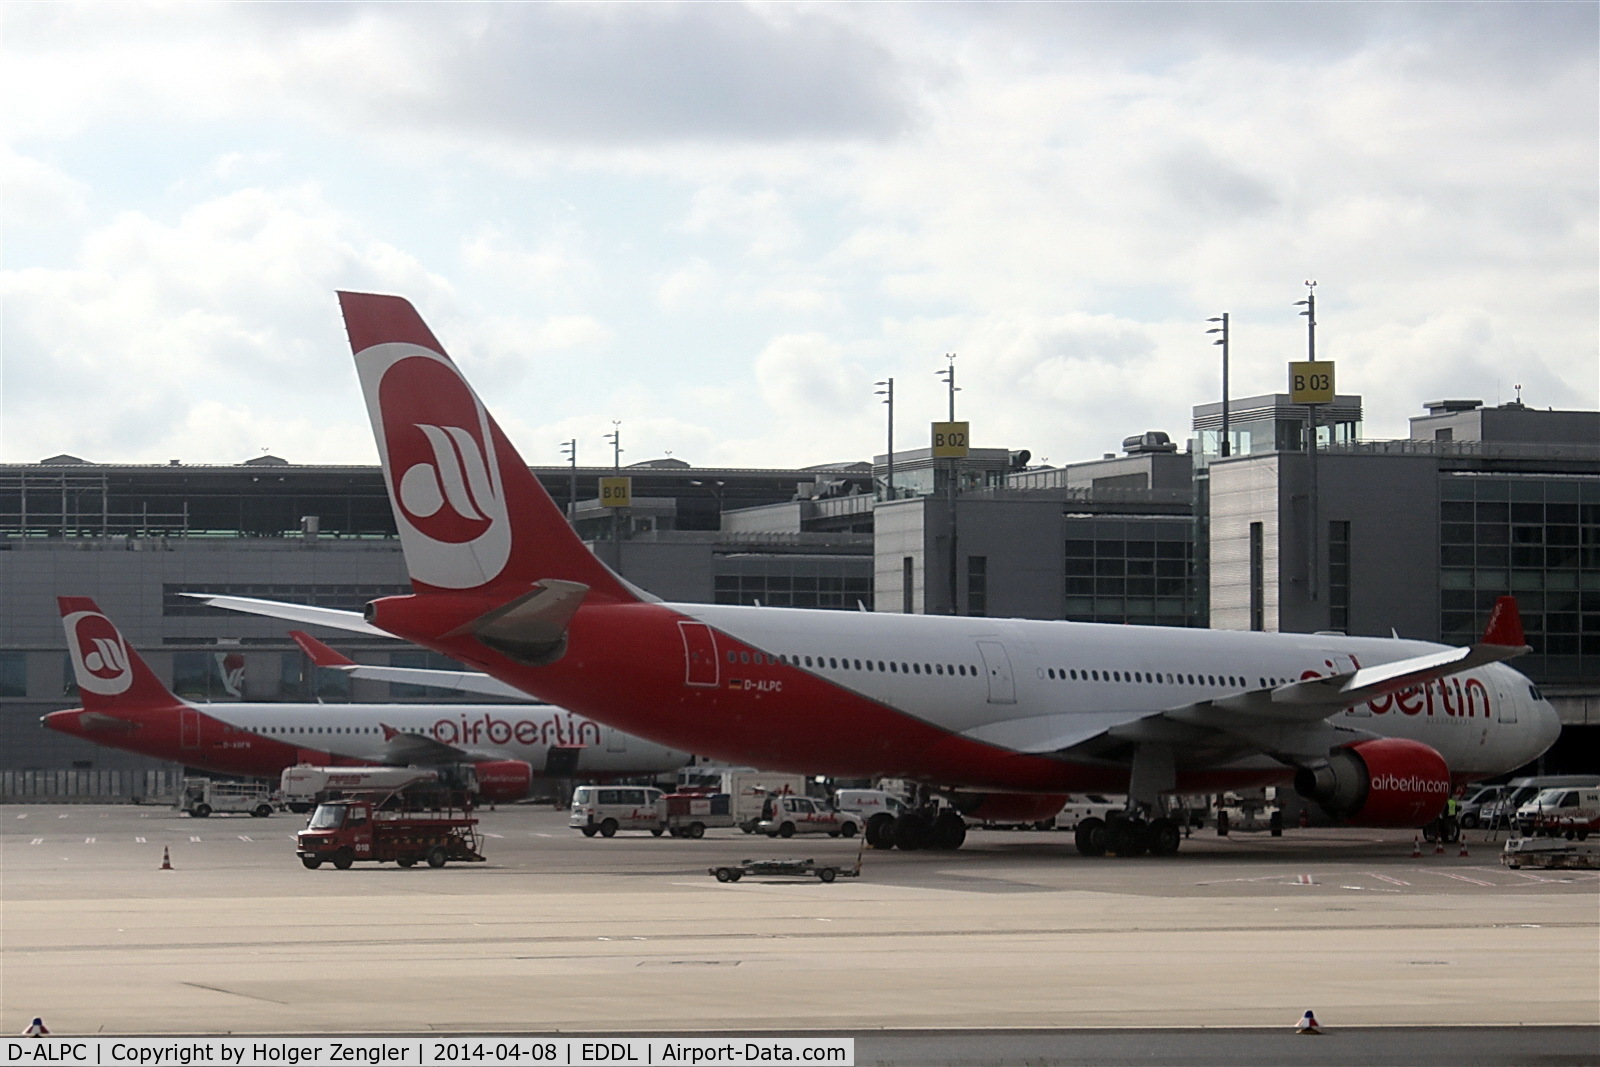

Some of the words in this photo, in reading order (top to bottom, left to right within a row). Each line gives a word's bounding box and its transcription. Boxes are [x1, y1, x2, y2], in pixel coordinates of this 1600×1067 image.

[1294, 375, 1305, 391] B
[1310, 374, 1329, 391] 03
[935, 433, 945, 447] B
[948, 432, 965, 447] 02
[603, 486, 611, 499] B
[614, 486, 626, 499] 01
[744, 679, 782, 692] D-ALPC
[434, 713, 600, 745] airberlin
[1371, 772, 1449, 793] airberlin.com
